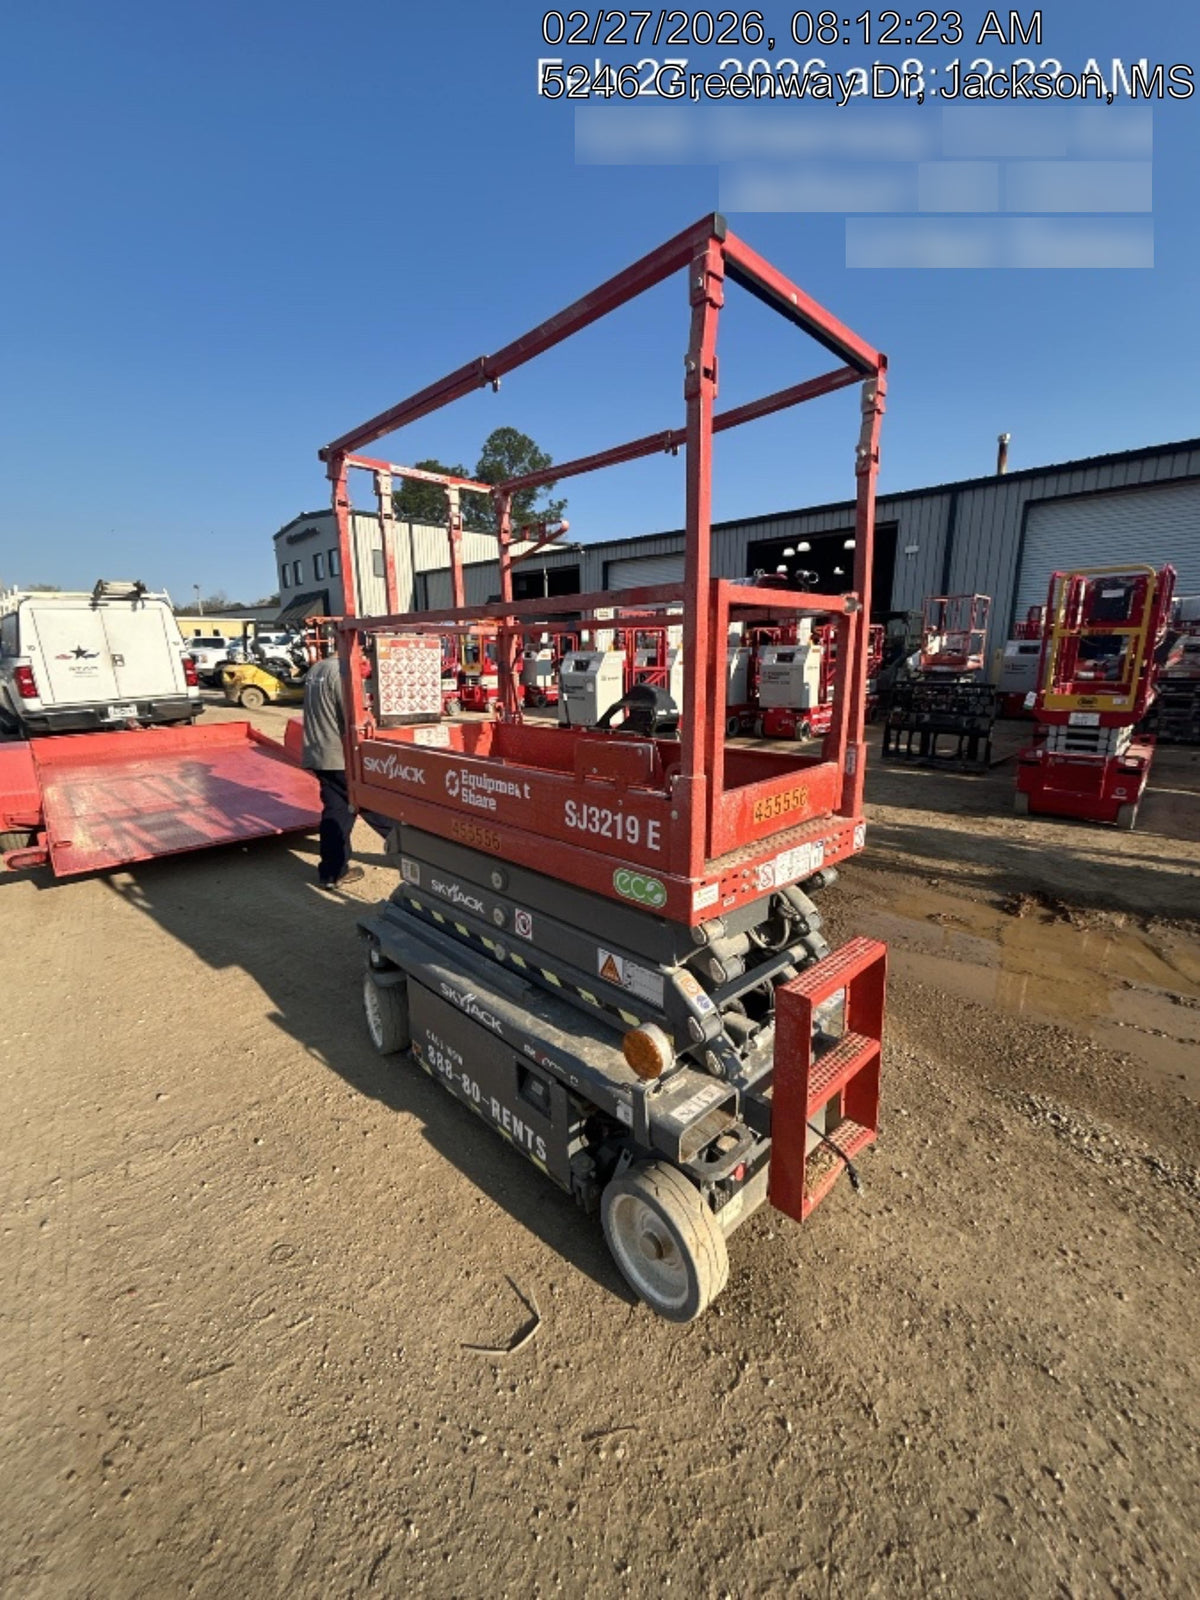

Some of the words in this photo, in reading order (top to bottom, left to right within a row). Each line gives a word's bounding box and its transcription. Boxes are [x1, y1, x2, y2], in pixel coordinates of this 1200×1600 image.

[363, 754, 426, 785] SKYJACK
[461, 788, 497, 811] Share
[564, 800, 640, 844] SJ3219
[646, 819, 661, 850] E
[431, 879, 485, 914] SKYJACK
[440, 982, 504, 1035] SKYJACK
